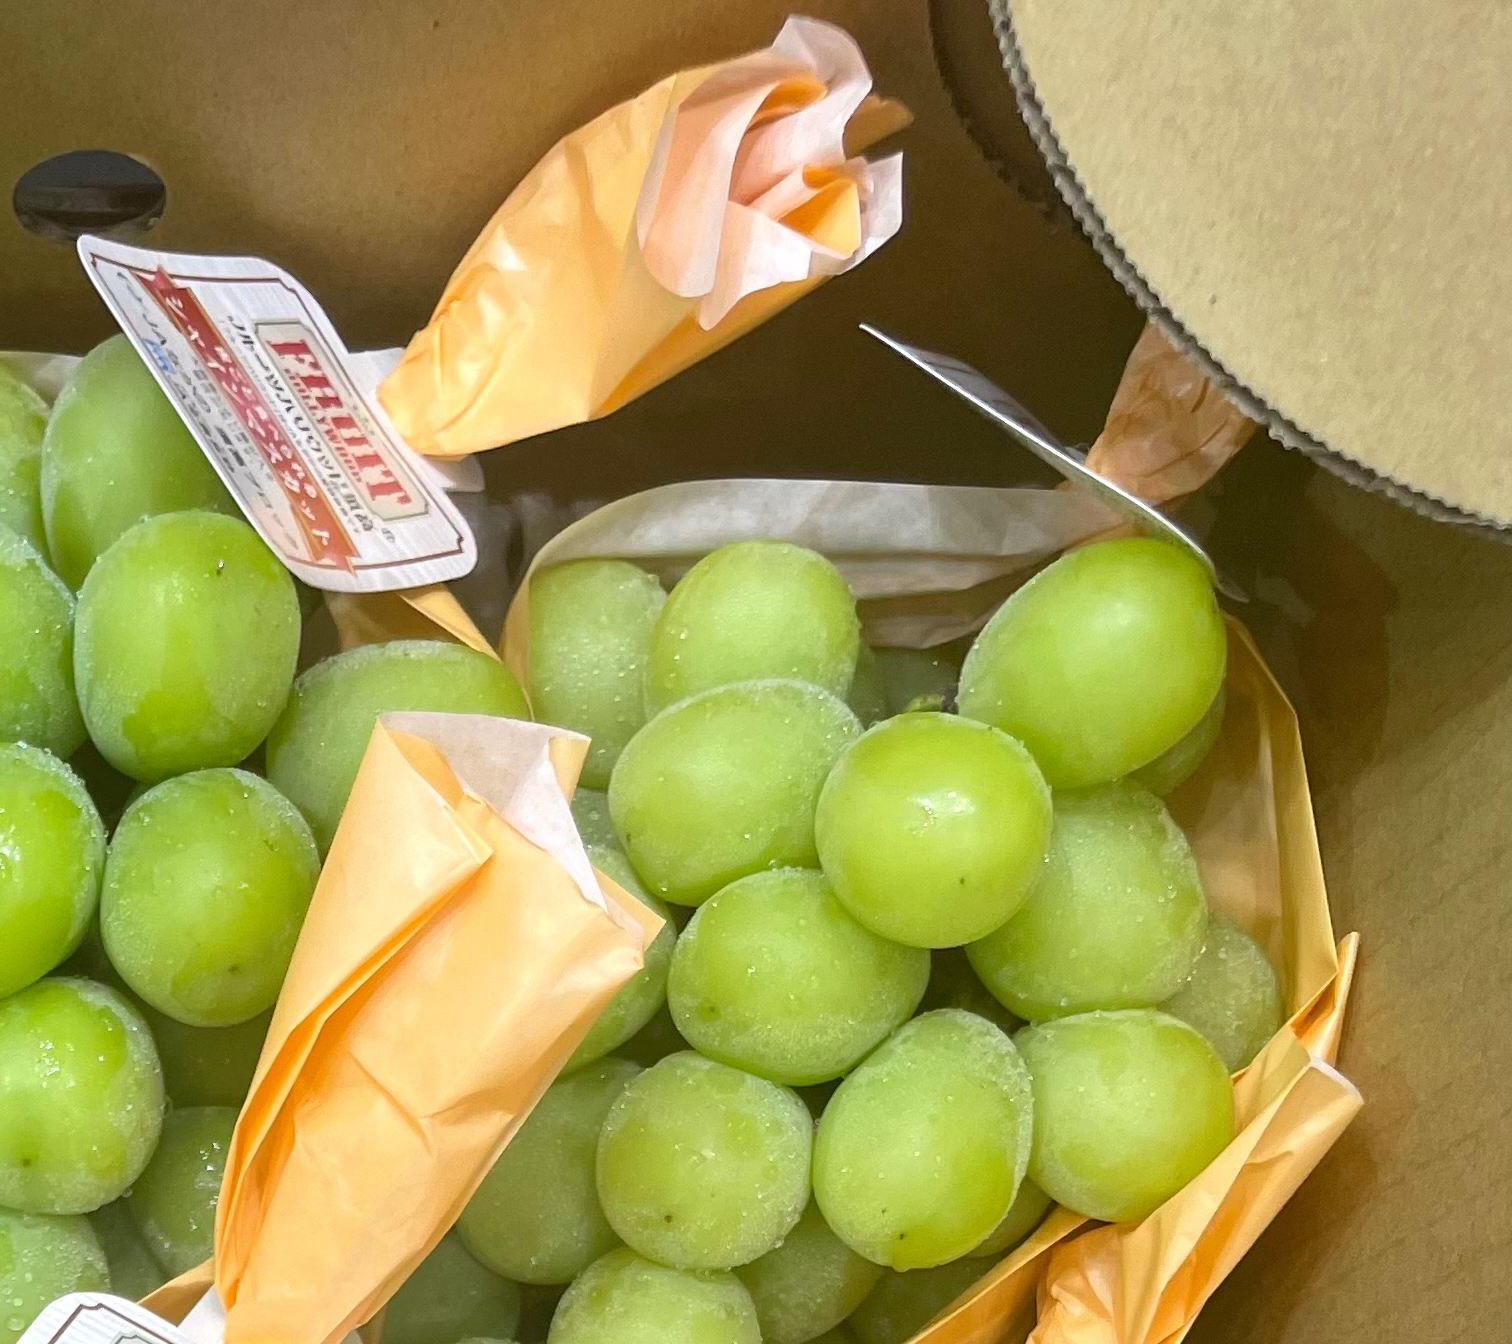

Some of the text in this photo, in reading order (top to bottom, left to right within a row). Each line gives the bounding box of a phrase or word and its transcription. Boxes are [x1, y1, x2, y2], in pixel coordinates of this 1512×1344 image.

[166, 296, 330, 545] シャインマスカット
[266, 339, 412, 504] FRUIT
